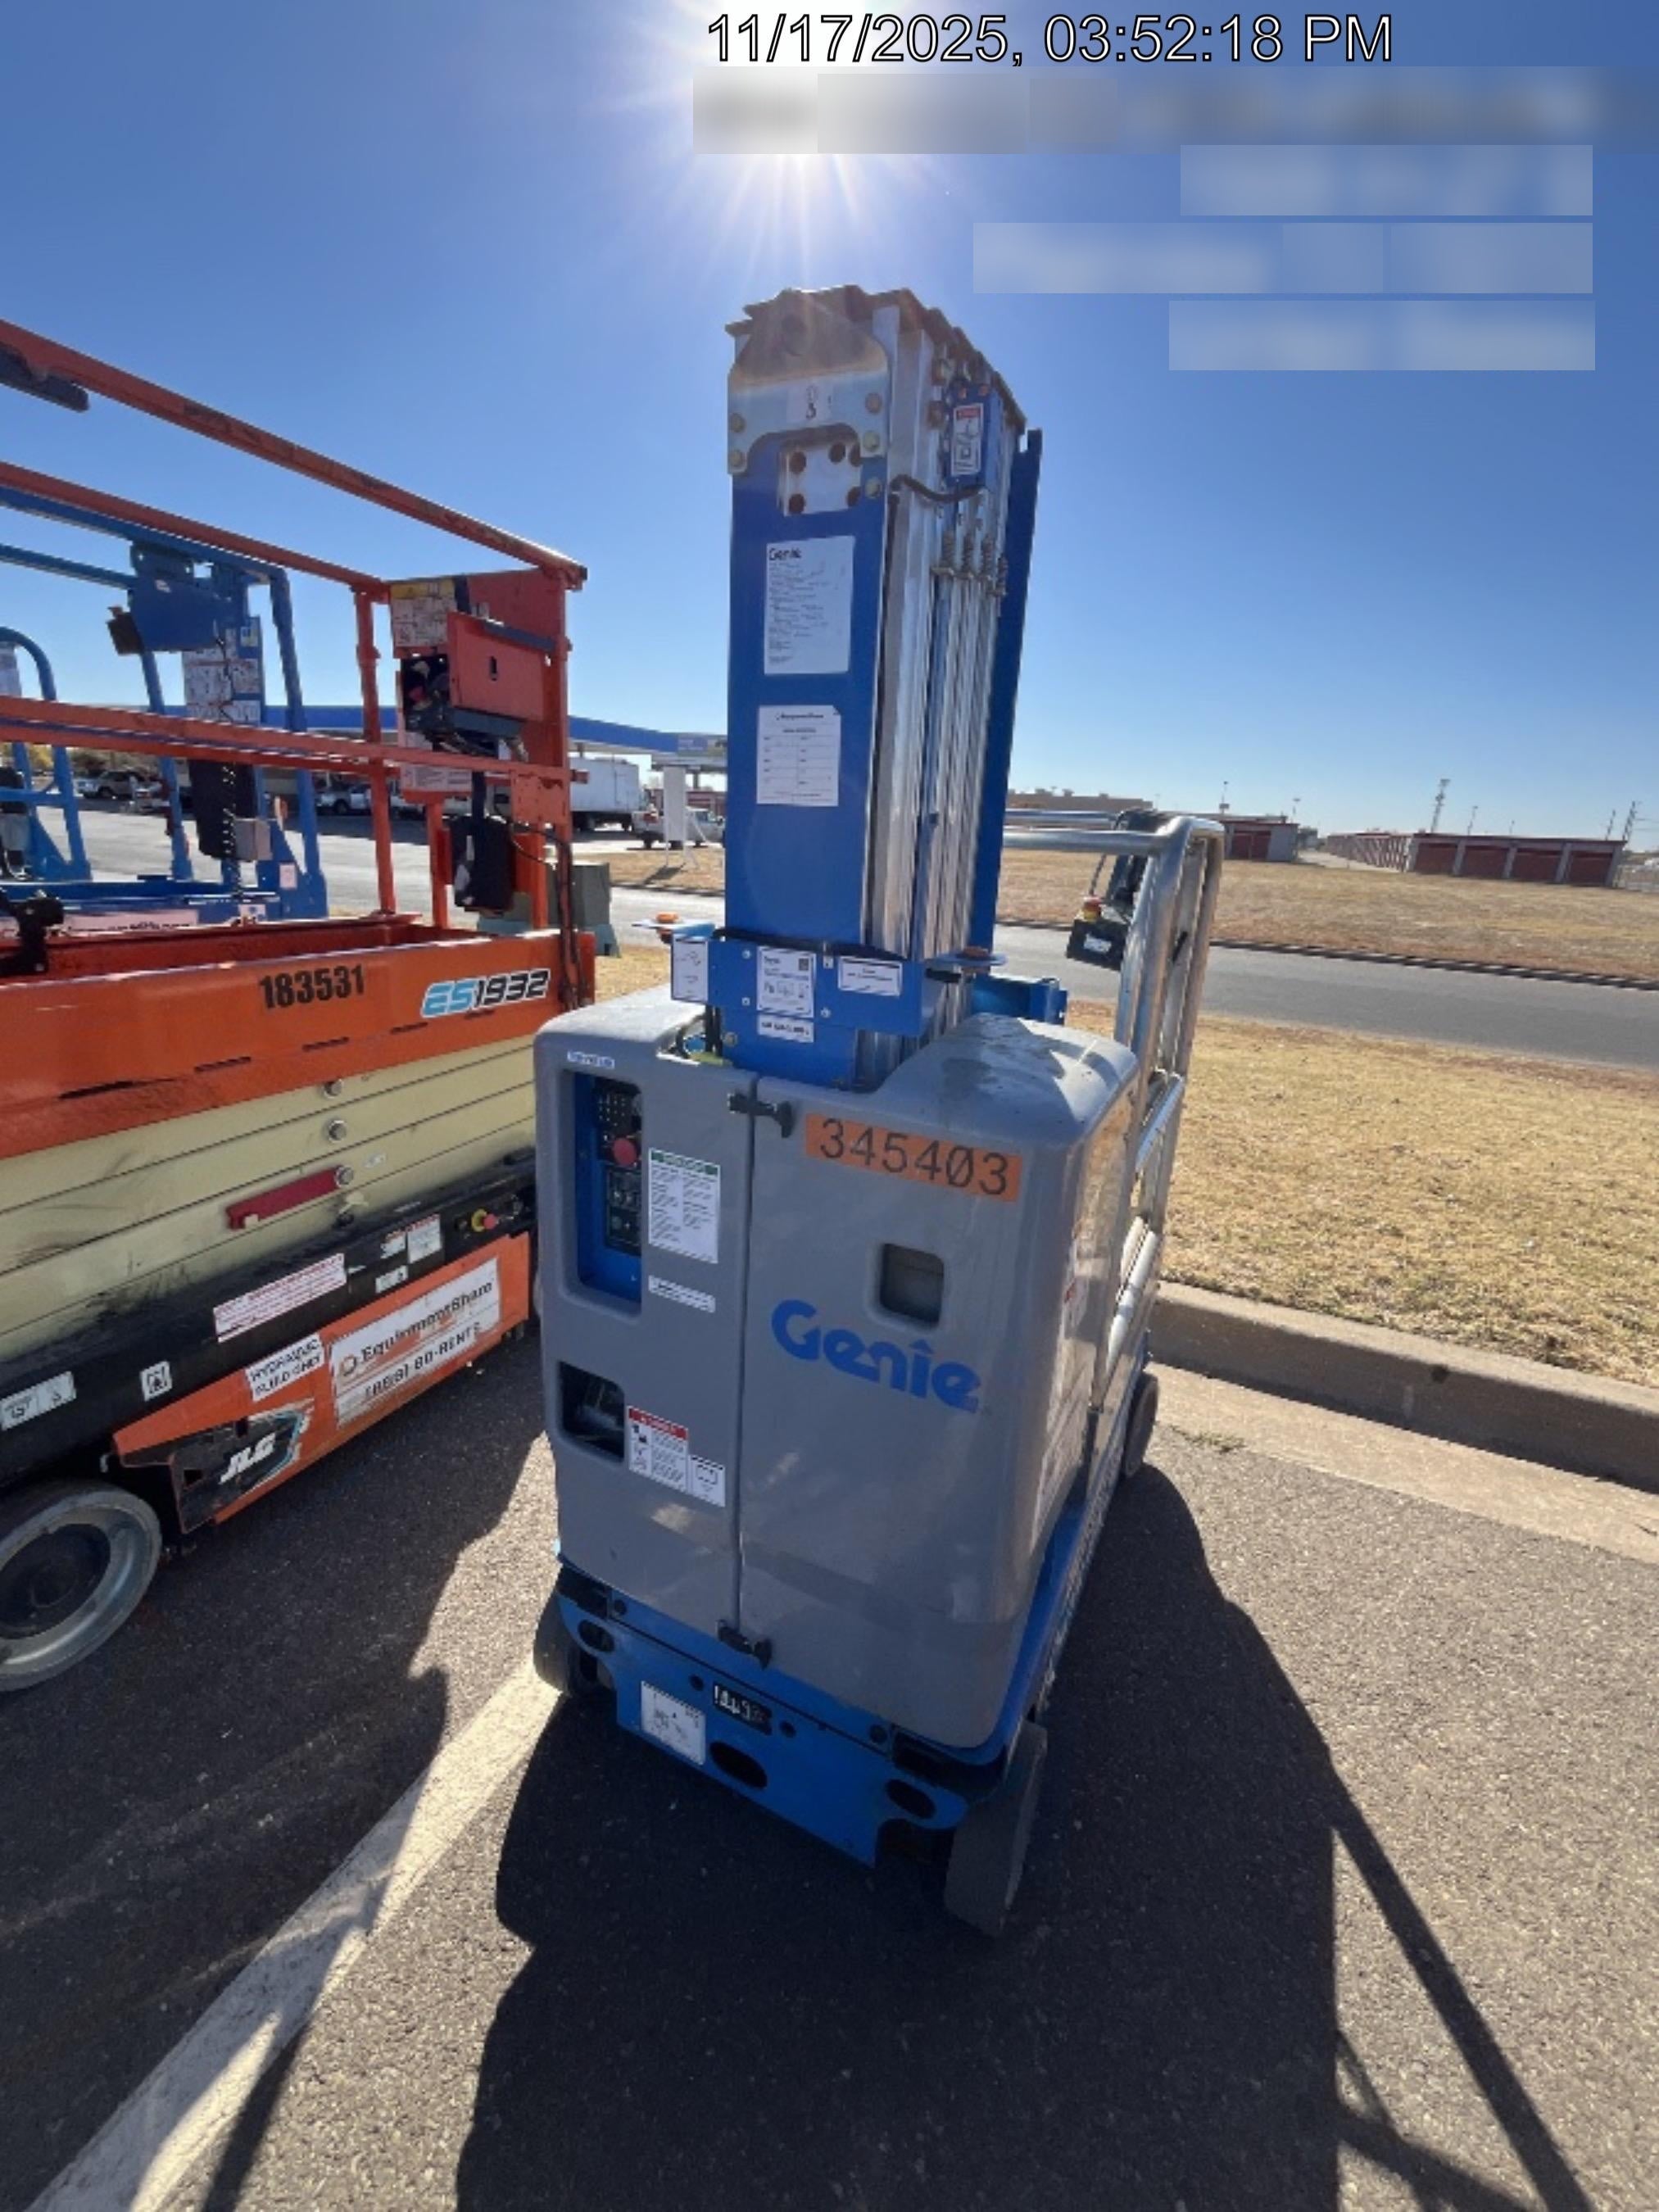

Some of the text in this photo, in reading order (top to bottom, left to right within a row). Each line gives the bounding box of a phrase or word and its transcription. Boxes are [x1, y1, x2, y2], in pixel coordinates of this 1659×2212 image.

[259, 964, 365, 1009] 183531
[420, 968, 550, 1018] ES1932
[820, 1117, 1009, 1195] 345403
[771, 1299, 981, 1414] Genie
